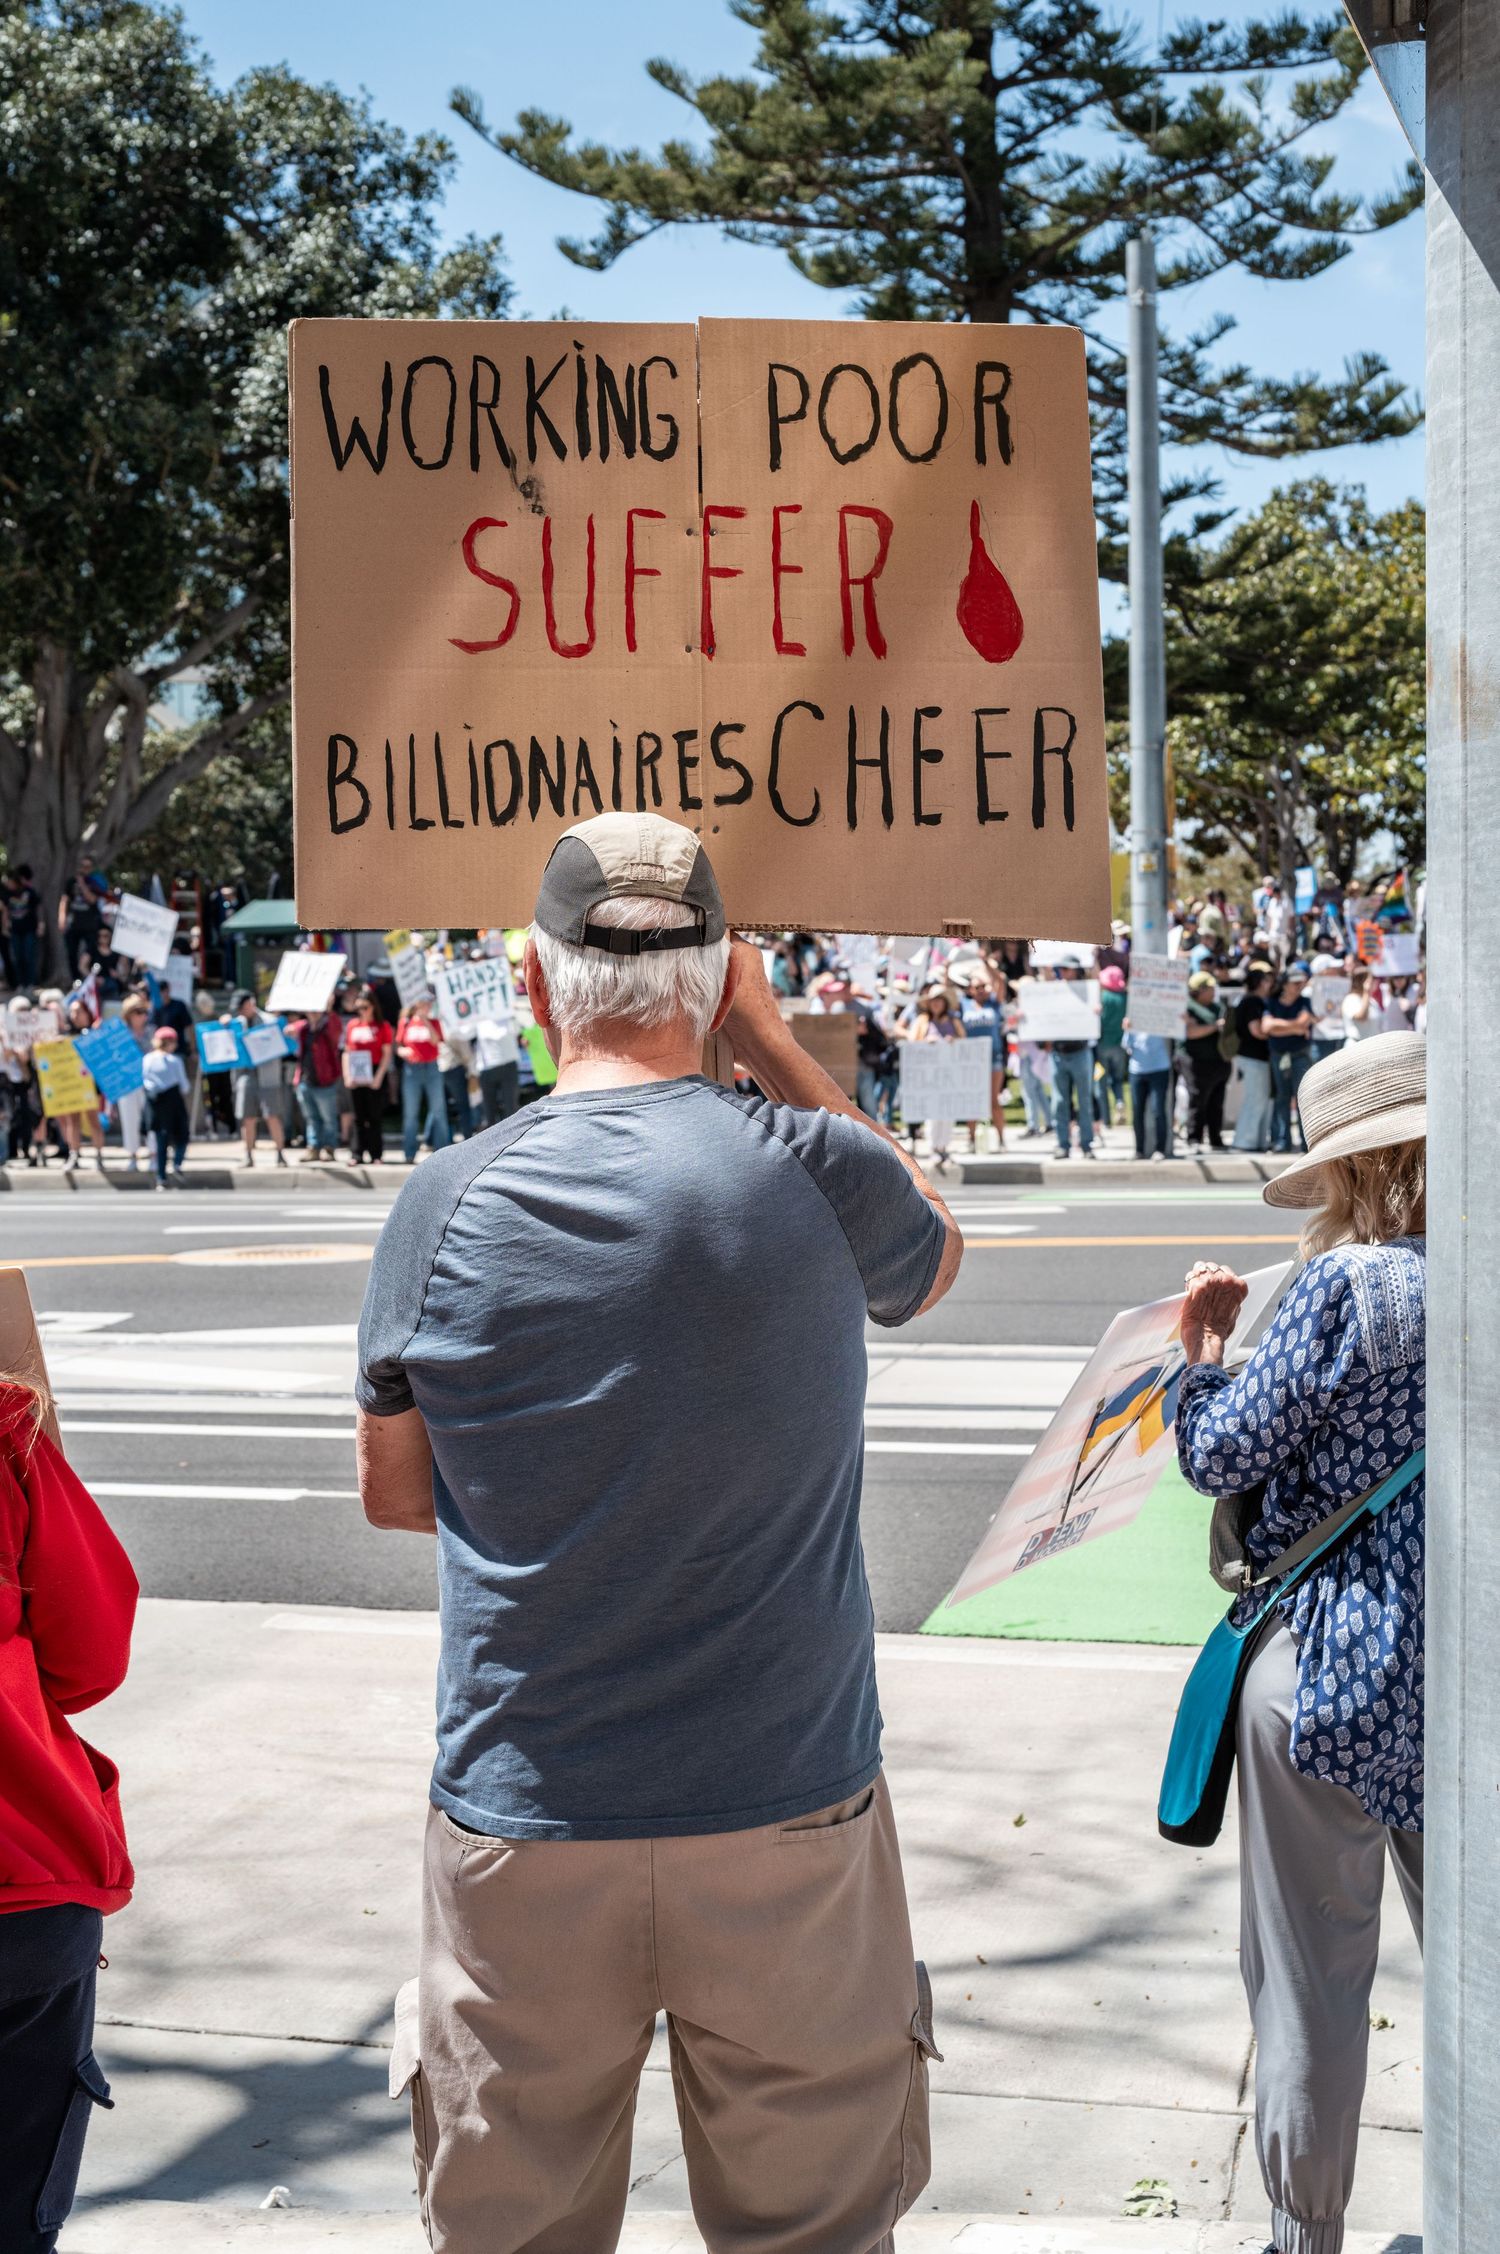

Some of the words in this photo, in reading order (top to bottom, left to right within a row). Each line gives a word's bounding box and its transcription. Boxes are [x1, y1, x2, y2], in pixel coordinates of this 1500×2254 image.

[768, 352, 1014, 473] POOR
[449, 503, 894, 660] SUFFER
[767, 700, 1077, 832] CHEER
[447, 961, 505, 995] HANDS
[455, 983, 509, 1018] OFF!
[1023, 1509, 1097, 1555] DFEND
